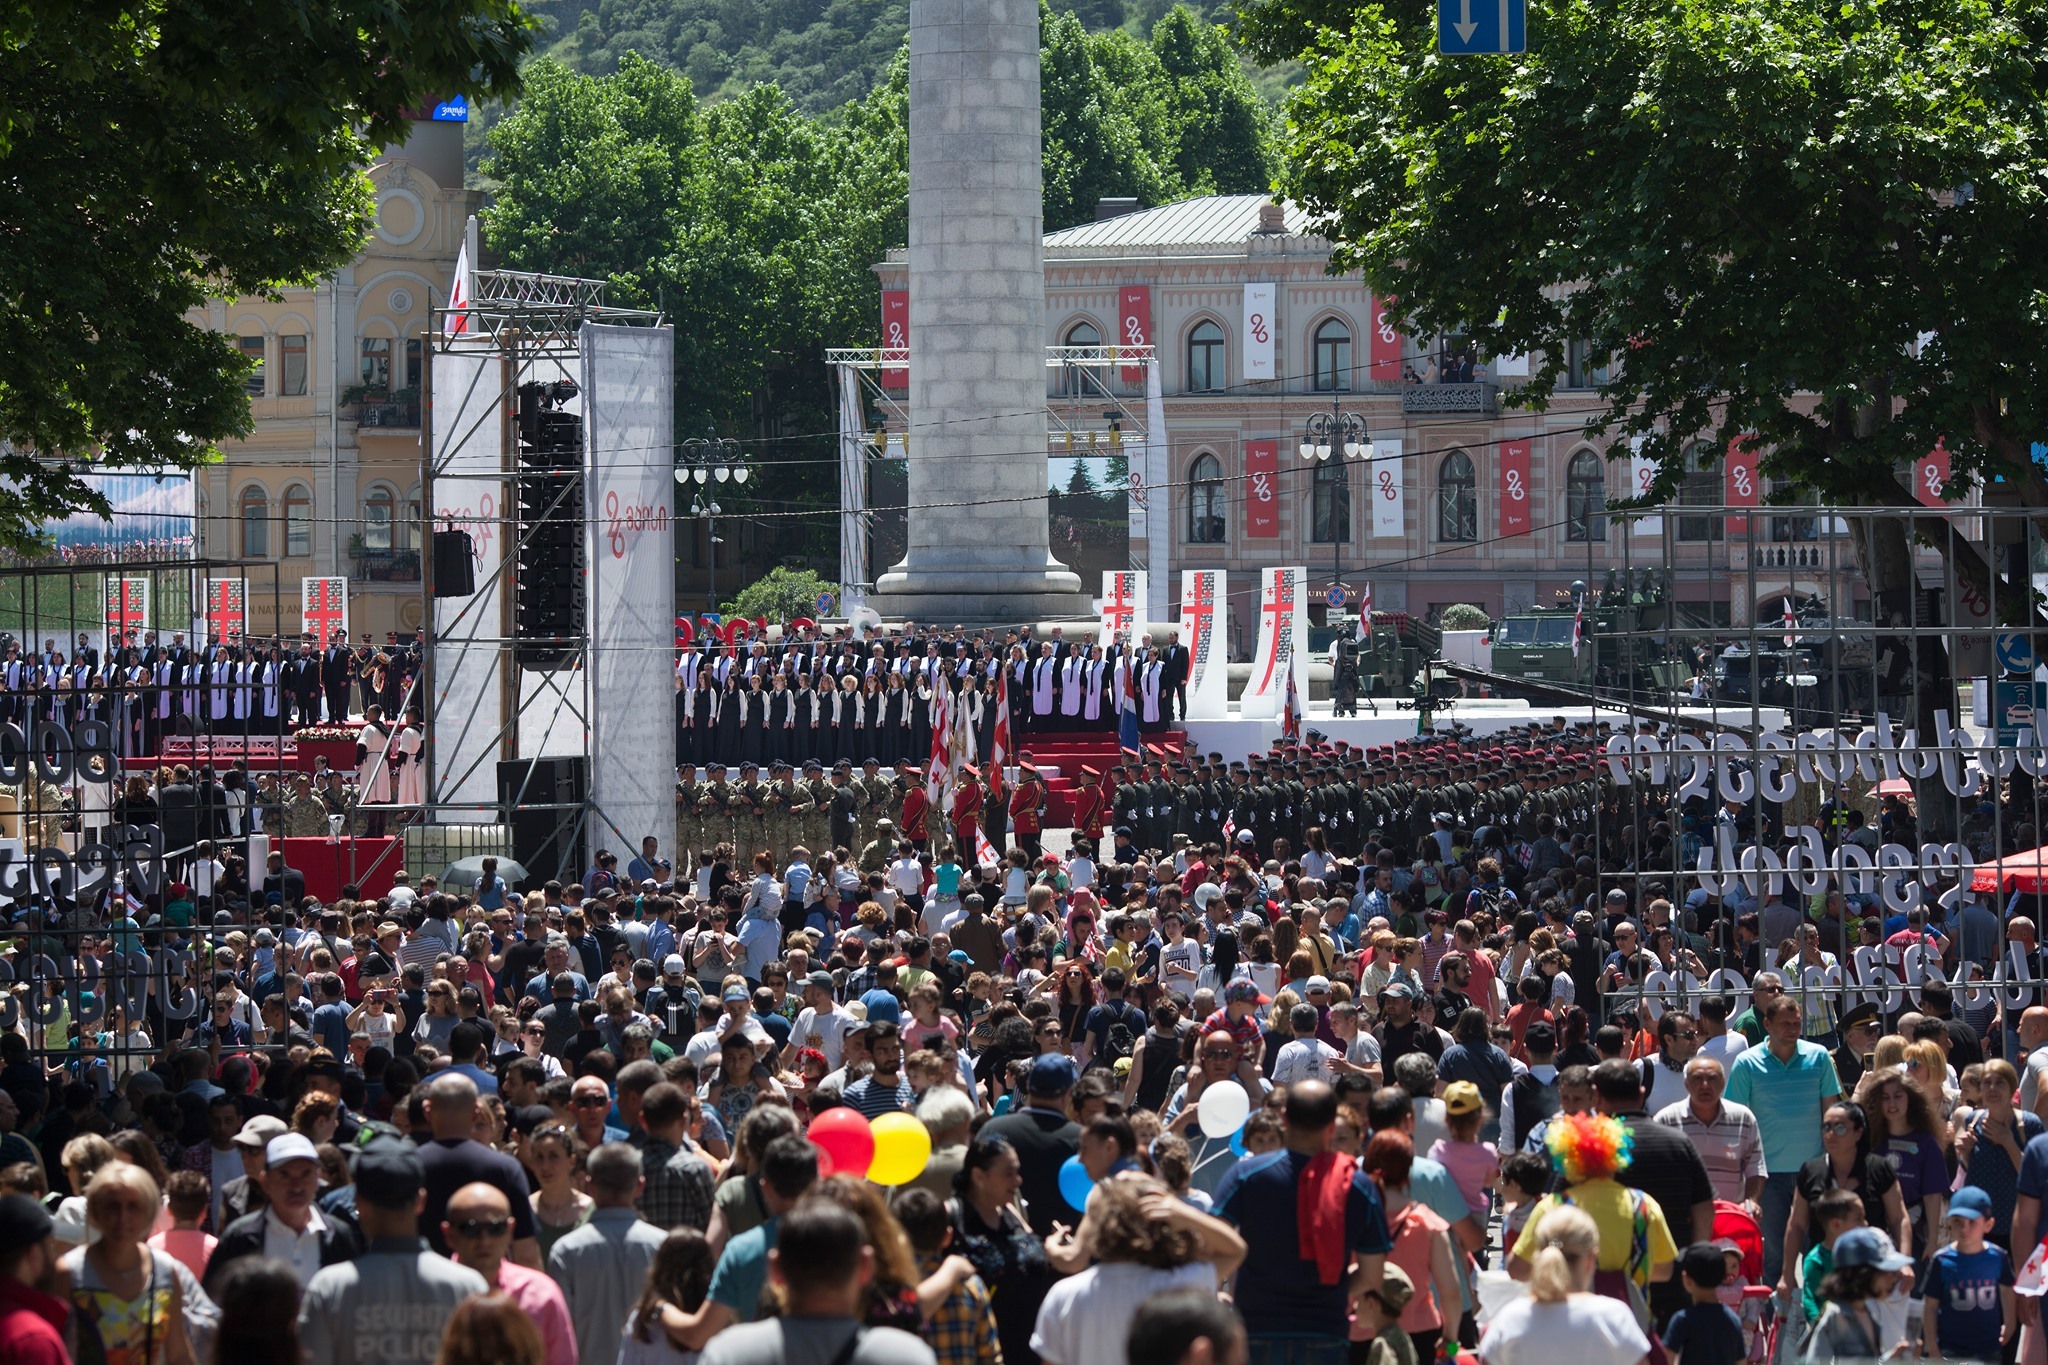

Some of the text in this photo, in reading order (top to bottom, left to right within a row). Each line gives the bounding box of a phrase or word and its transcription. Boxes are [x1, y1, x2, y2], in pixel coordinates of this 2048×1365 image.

[258, 605, 283, 615] NATO
[287, 605, 300, 614] AN
[354, 1333, 440, 1361] POLIC
